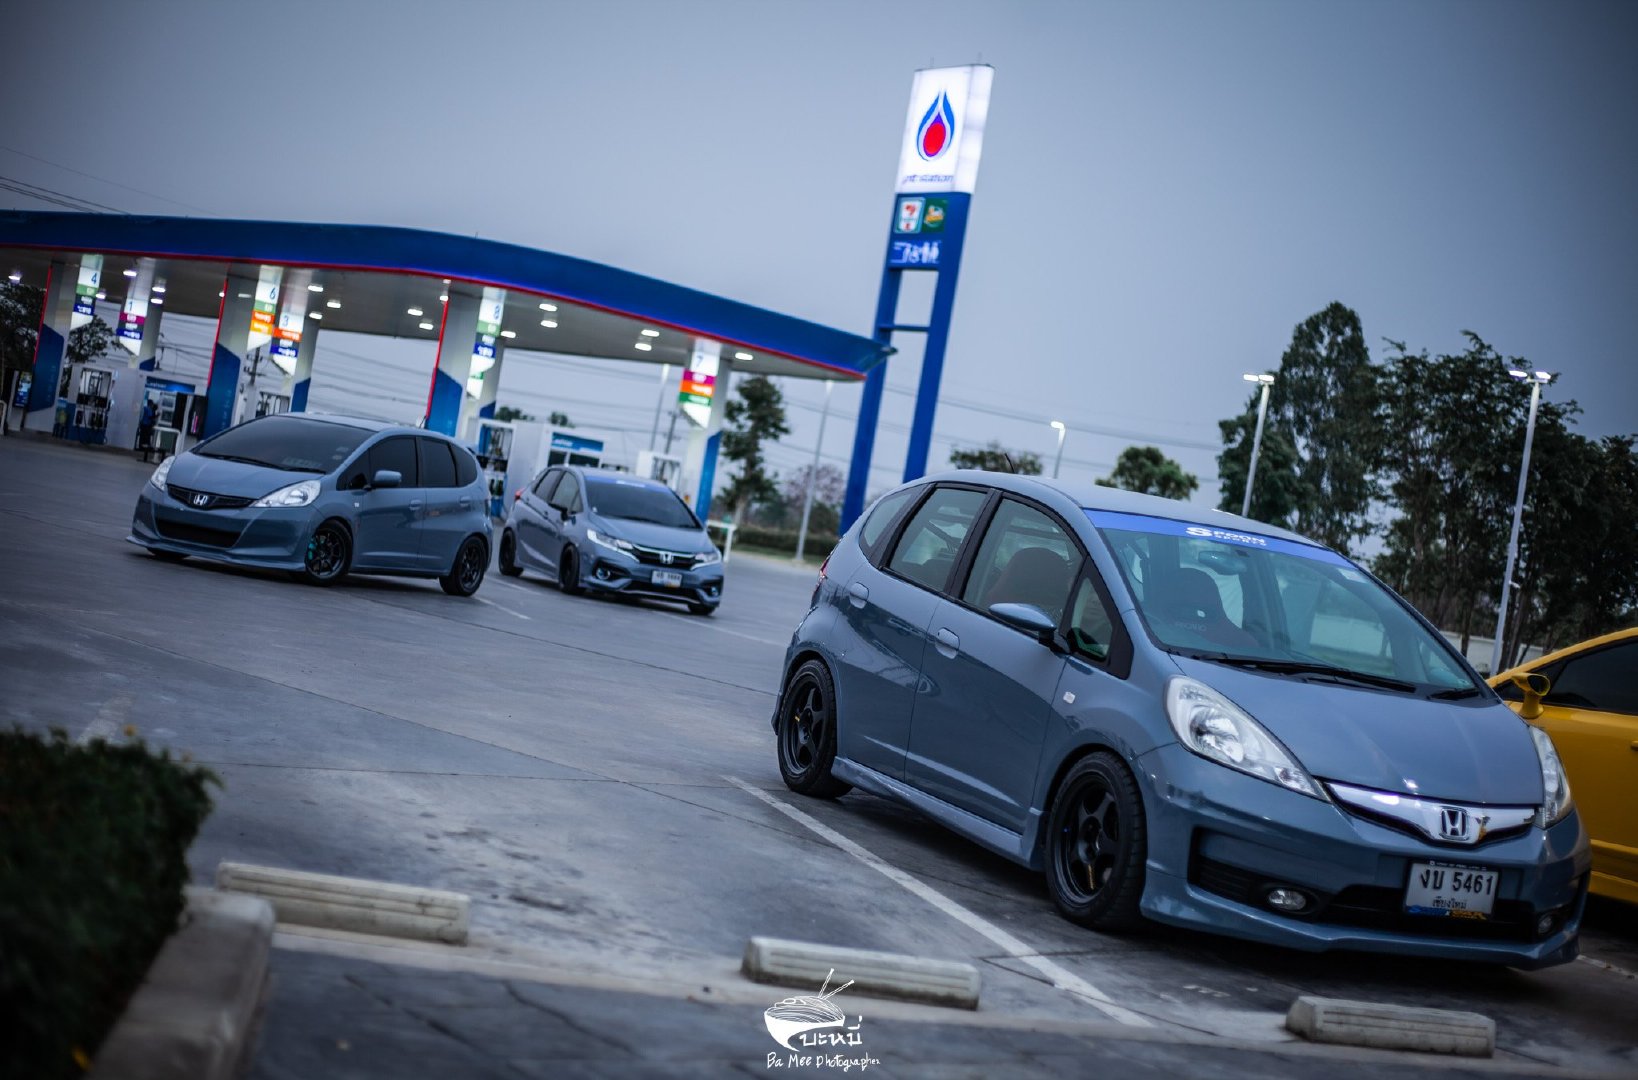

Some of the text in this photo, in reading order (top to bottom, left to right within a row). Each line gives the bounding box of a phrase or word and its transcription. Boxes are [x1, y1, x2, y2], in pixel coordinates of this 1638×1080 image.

[91, 272, 97, 285] 4
[269, 287, 276, 300] 6
[1185, 526, 1266, 545] SPOON
[1420, 869, 1494, 895] งบ 5461
